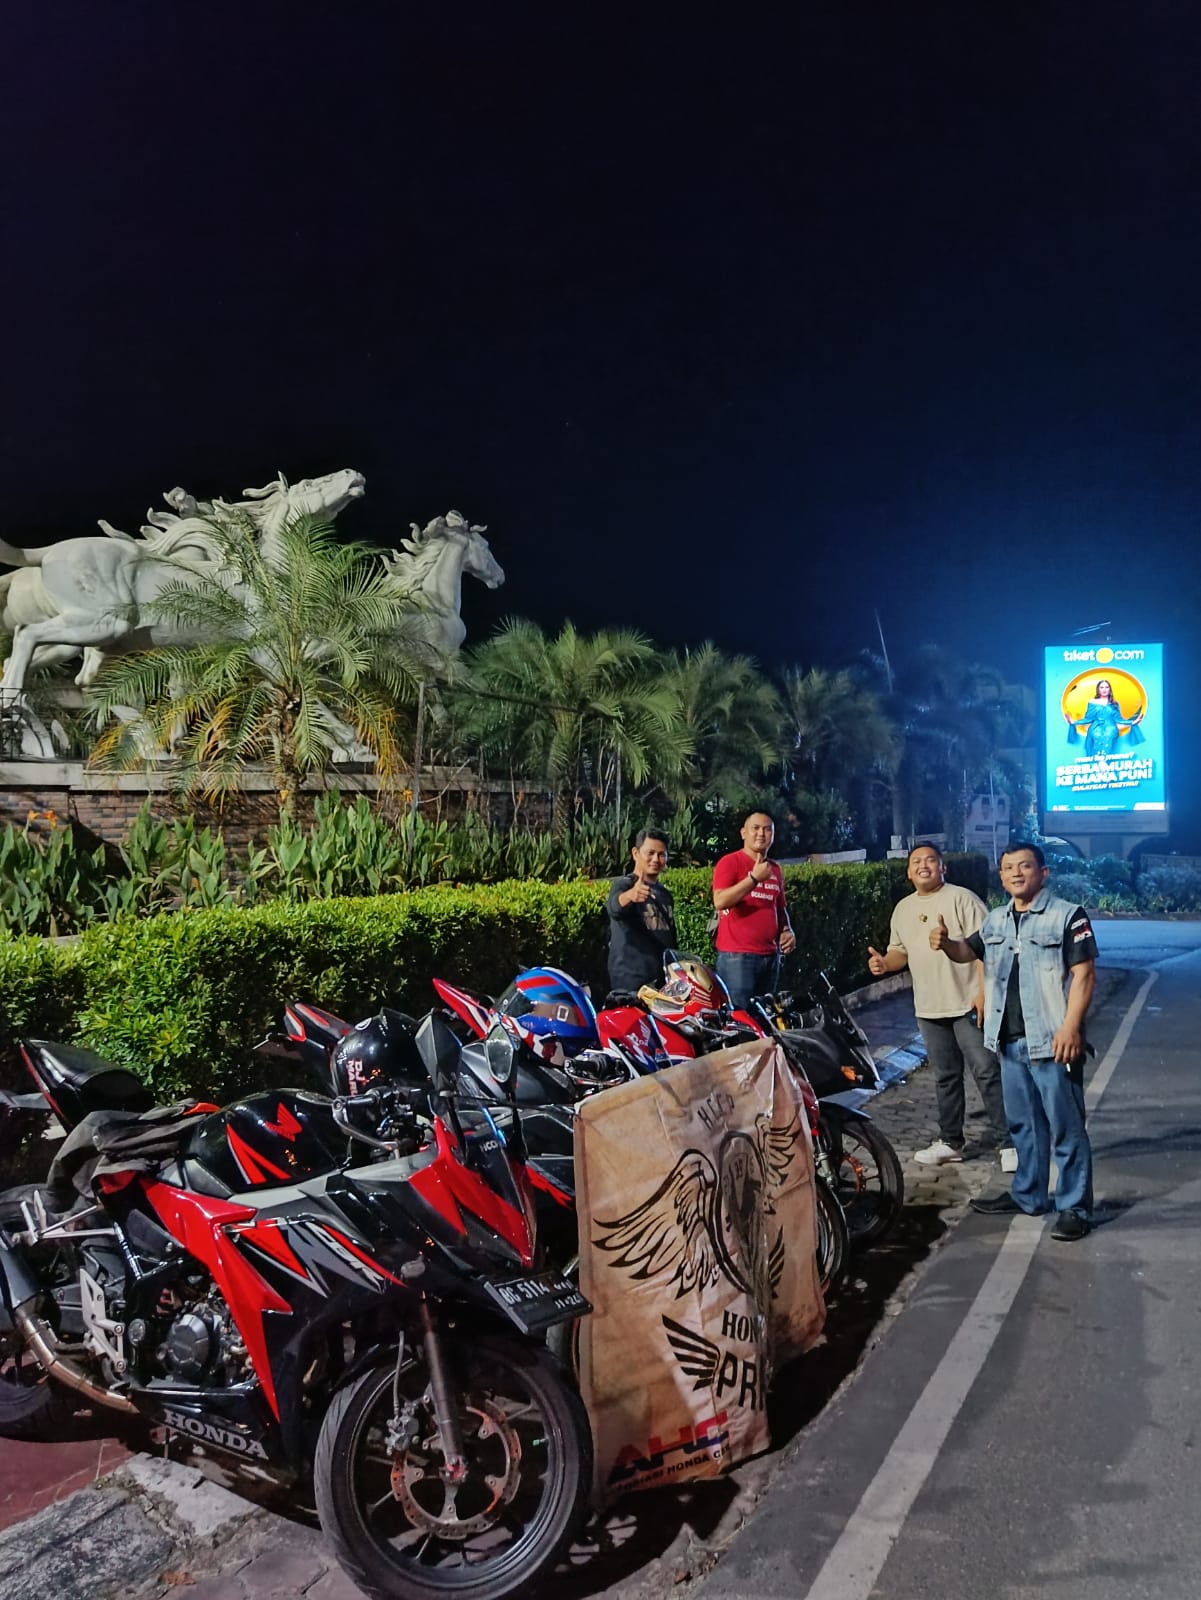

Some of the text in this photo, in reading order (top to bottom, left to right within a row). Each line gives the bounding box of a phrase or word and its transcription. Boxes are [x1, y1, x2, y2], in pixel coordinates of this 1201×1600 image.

[1103, 758, 1153, 773] MURAH
[1074, 772, 1118, 785] MANA
[163, 1408, 270, 1460] HONDA
[666, 1453, 711, 1476] HONDA
